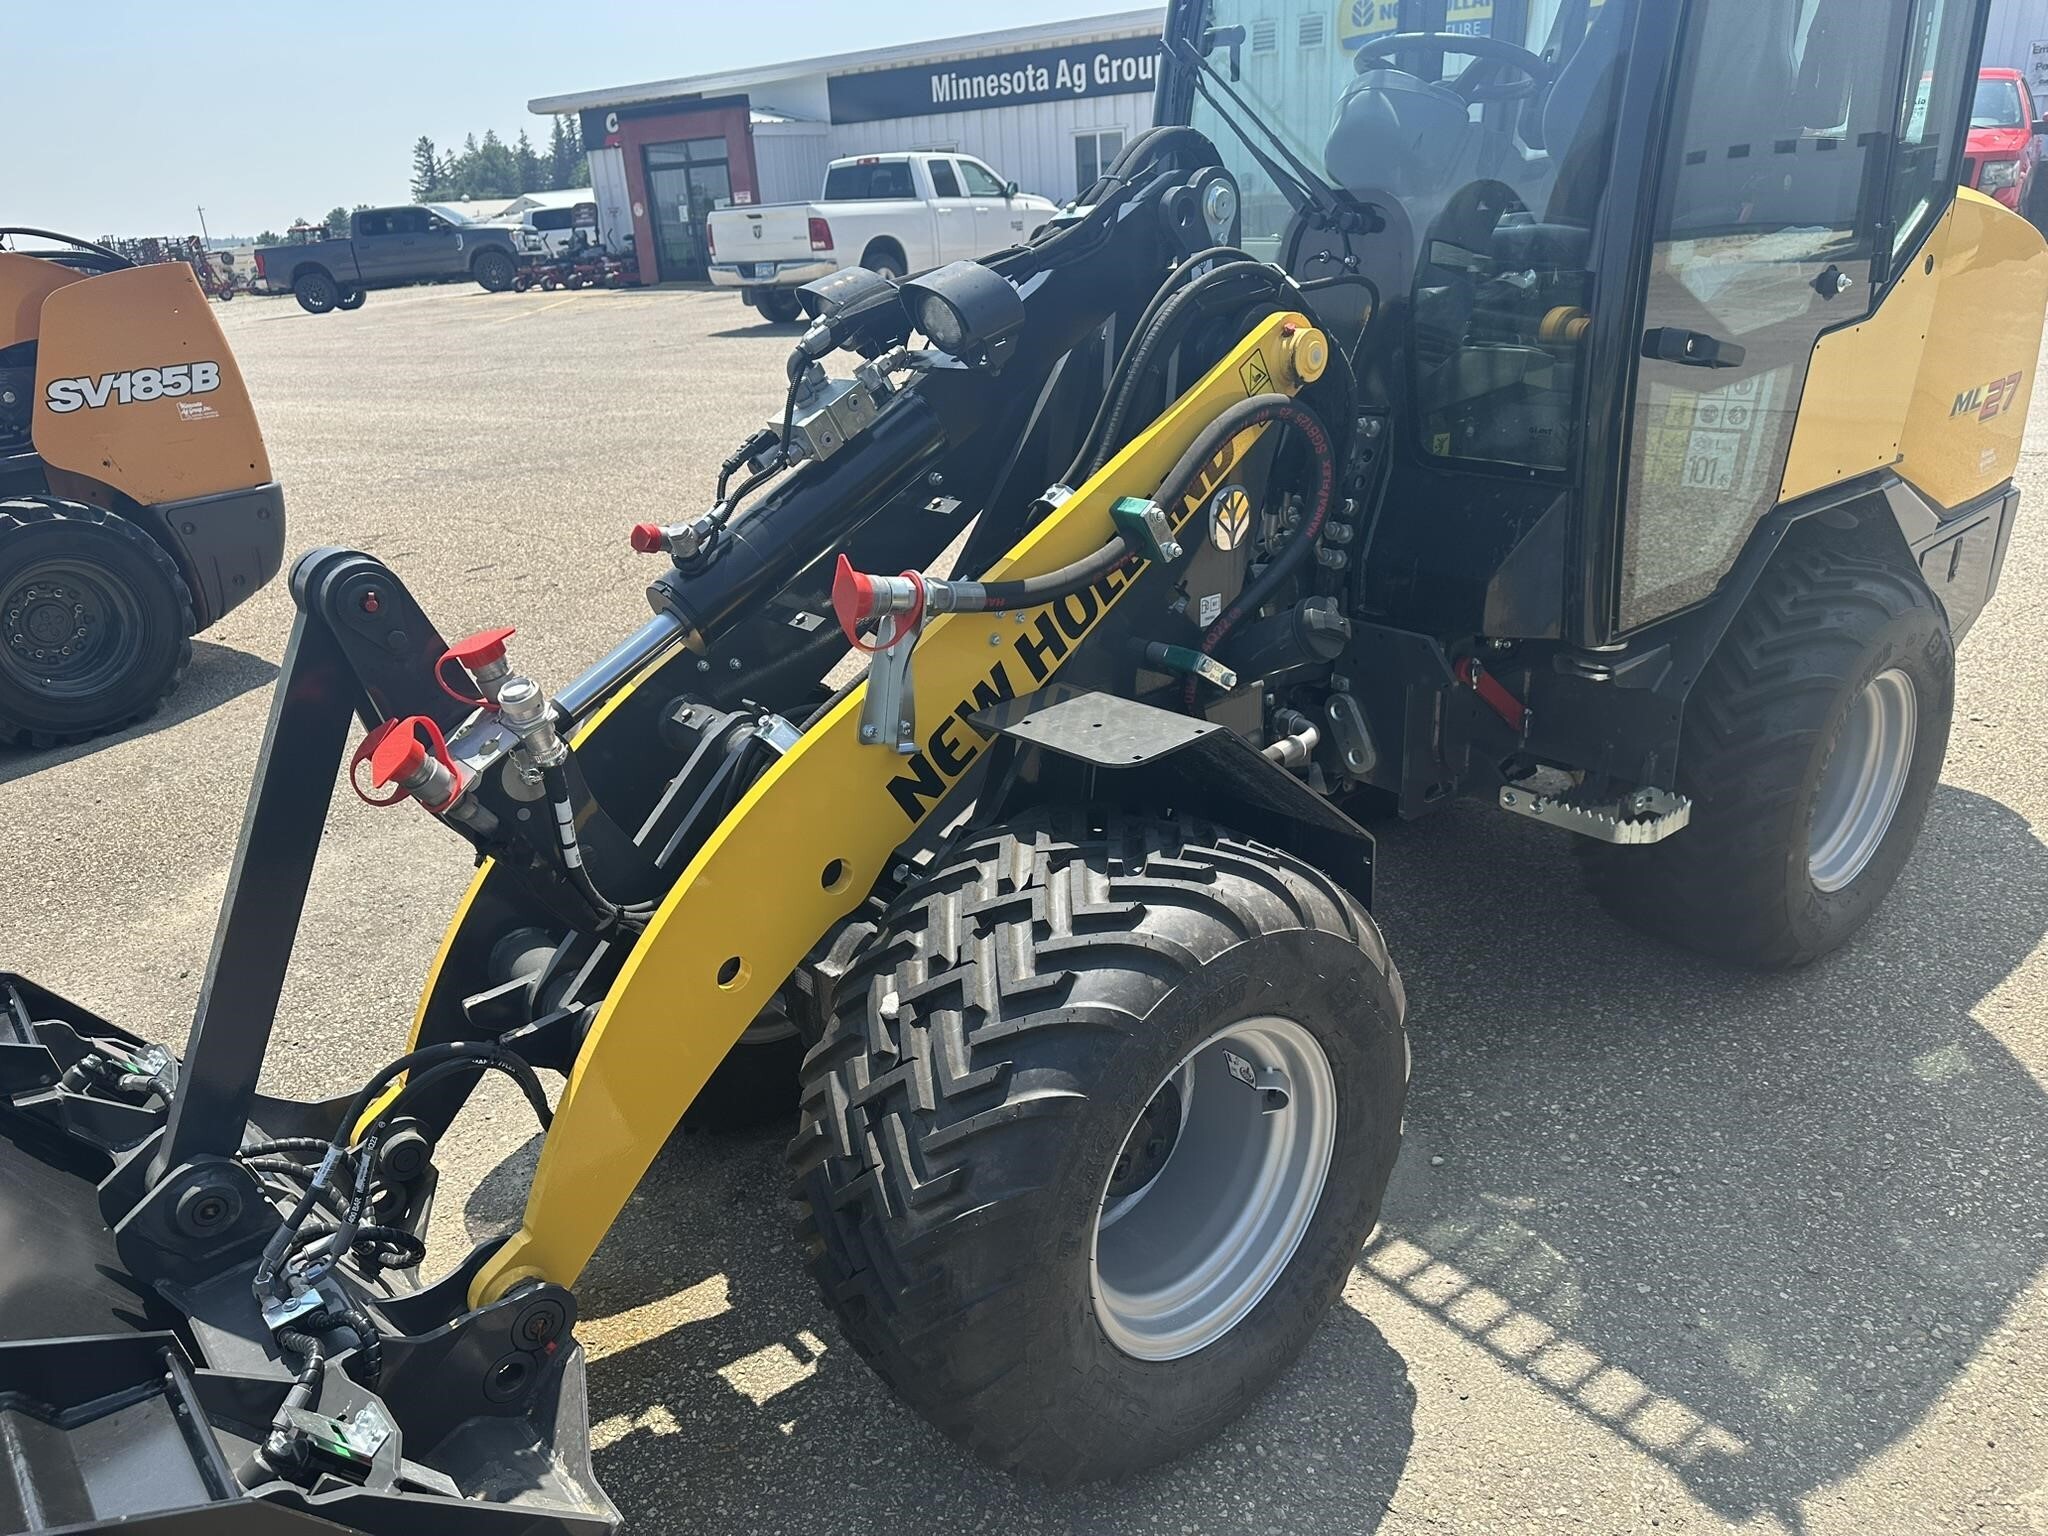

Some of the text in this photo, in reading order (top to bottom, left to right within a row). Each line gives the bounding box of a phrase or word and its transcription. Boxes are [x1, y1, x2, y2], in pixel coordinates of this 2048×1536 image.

[931, 63, 1049, 103] Minnesota
[1055, 58, 1087, 93] Ag
[46, 361, 220, 413] SV185B
[1949, 370, 2022, 423] ML27
[885, 432, 1236, 824] NEW HOLLND
